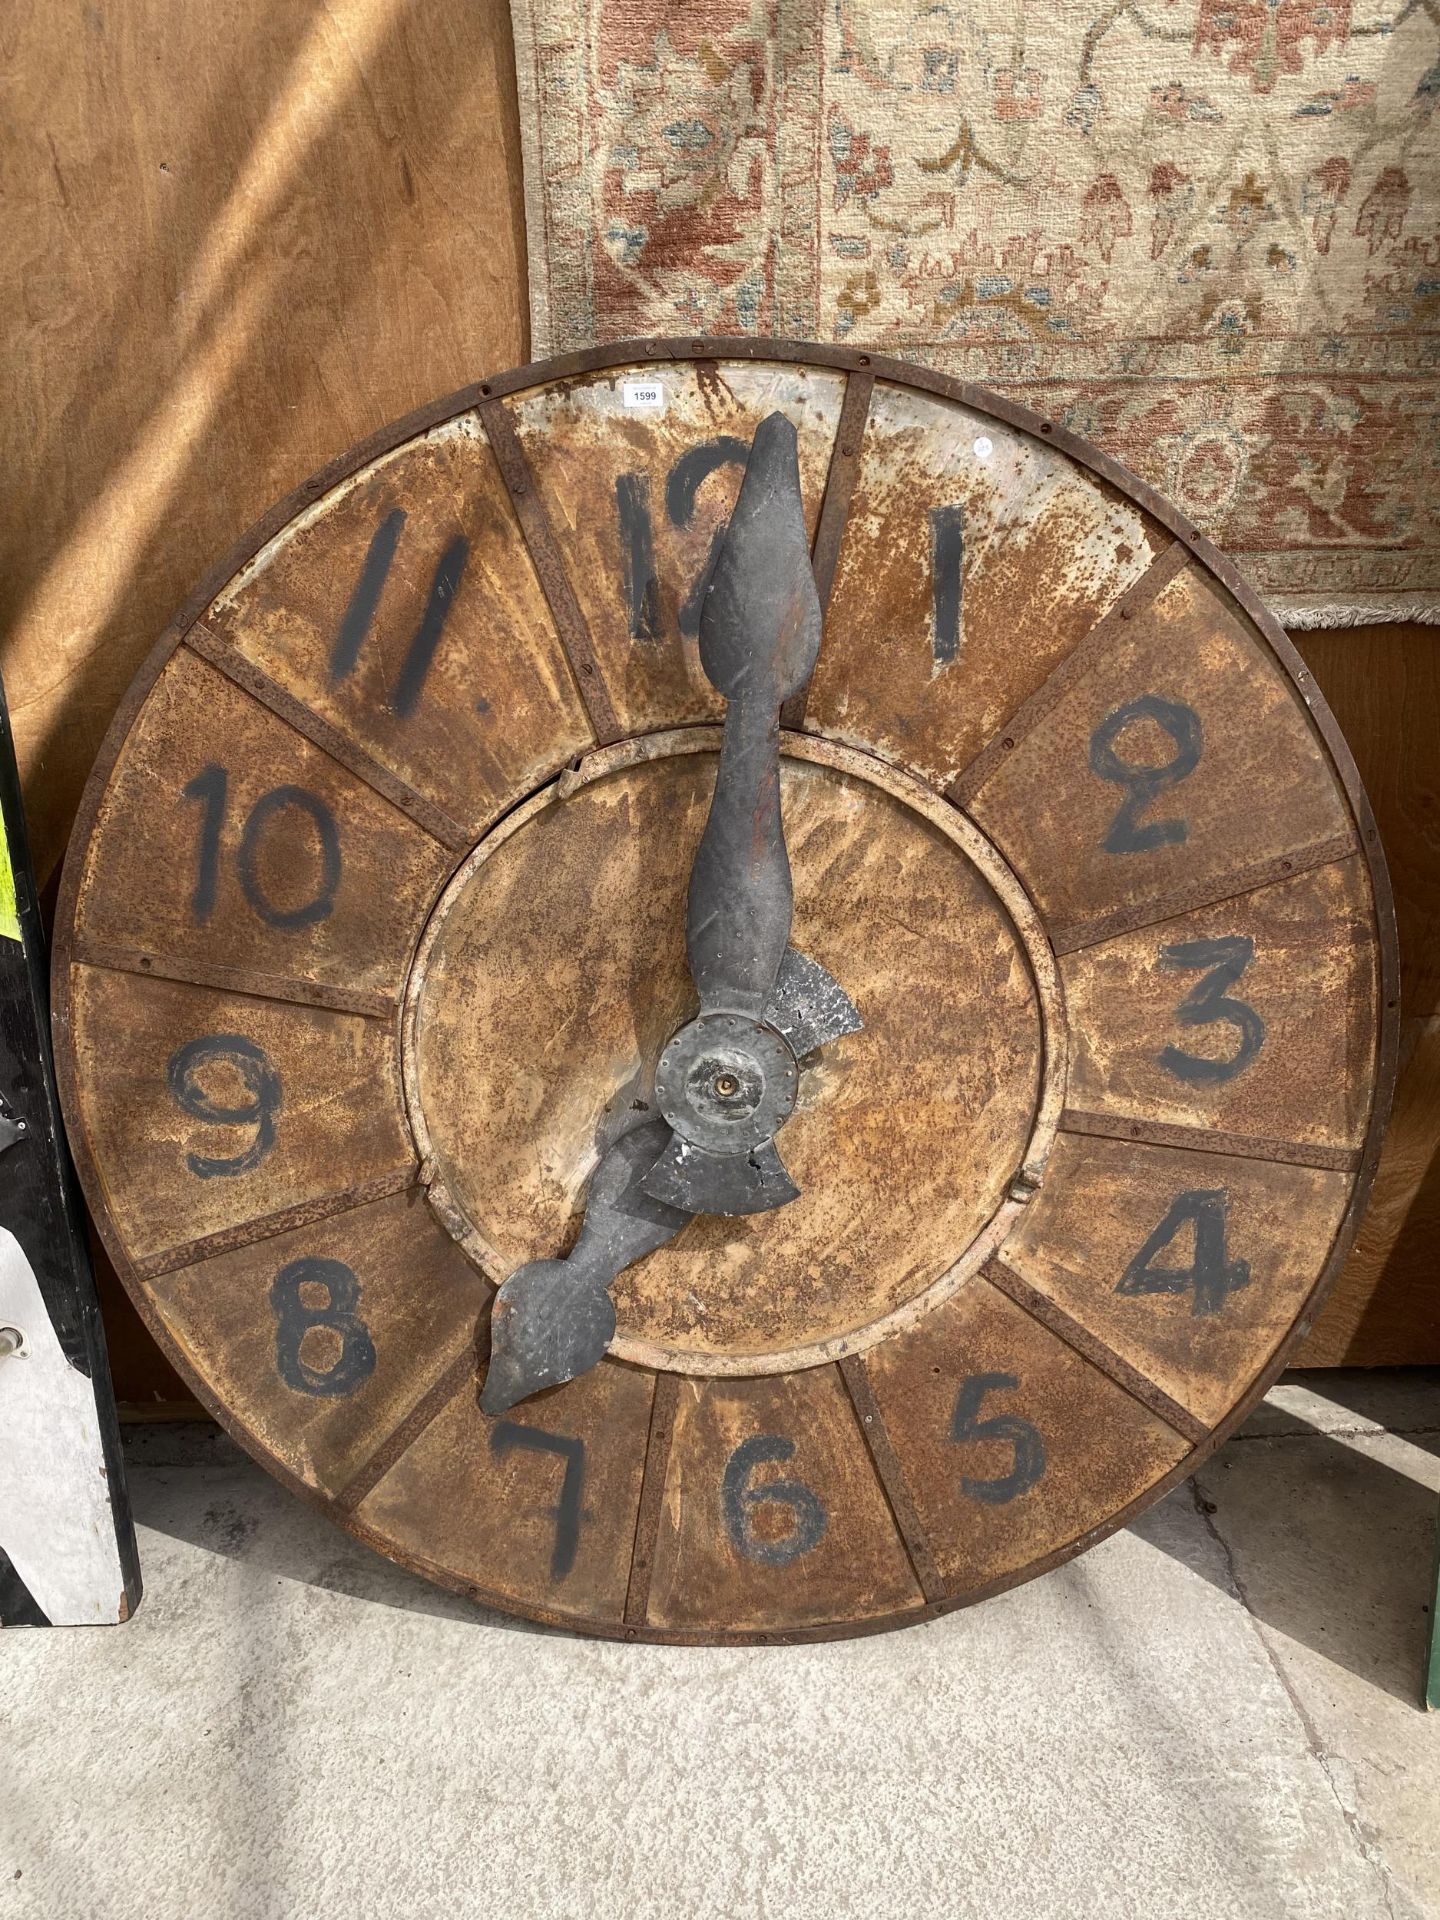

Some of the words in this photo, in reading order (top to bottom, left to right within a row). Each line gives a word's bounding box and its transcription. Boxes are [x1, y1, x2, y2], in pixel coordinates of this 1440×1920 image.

[634, 391, 657, 401] 1599
[328, 508, 470, 719] 11
[929, 503, 964, 664] 1
[180, 762, 342, 930] 10
[1089, 694, 1202, 854] 2
[1156, 934, 1265, 1085] 3
[167, 1034, 282, 1179] 9
[1113, 1186, 1251, 1316] 4
[269, 1256, 377, 1398] 8
[490, 1418, 585, 1583] 7
[721, 1434, 828, 1566] 6
[950, 1372, 1046, 1504] 5
